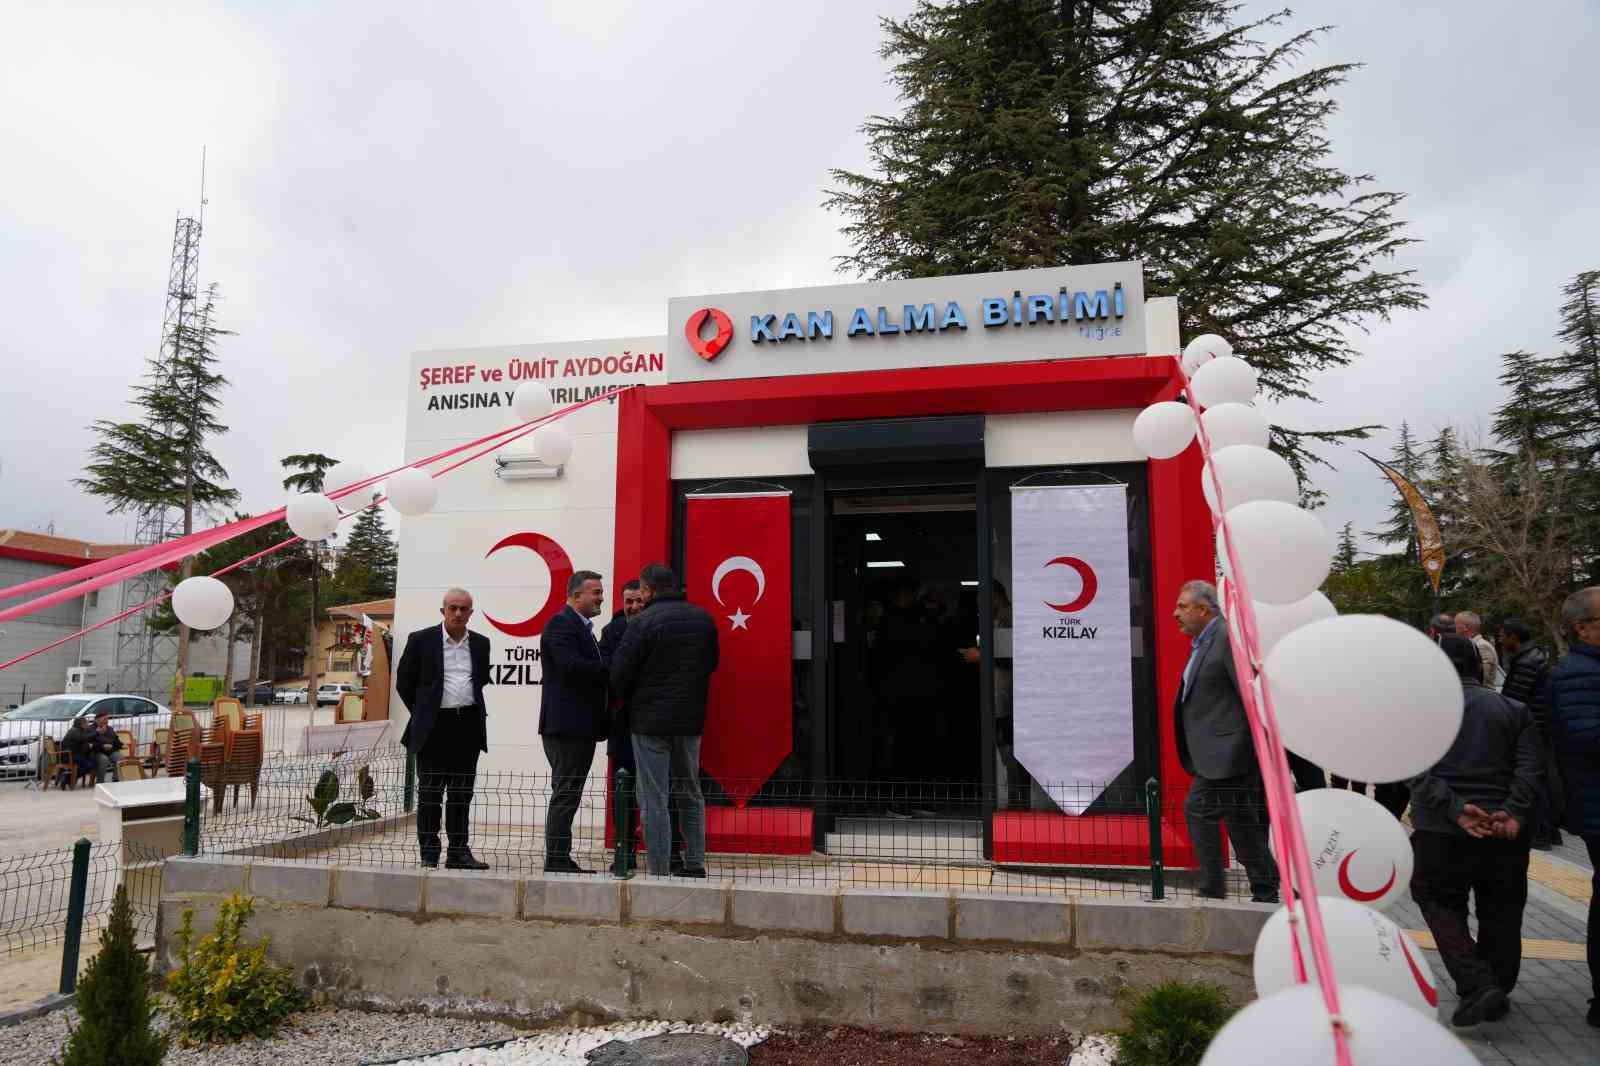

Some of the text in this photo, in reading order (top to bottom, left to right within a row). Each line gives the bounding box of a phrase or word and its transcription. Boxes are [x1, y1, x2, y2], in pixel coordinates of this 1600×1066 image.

[750, 281, 1124, 343] KAN ALMA BİRİMİ
[420, 350, 664, 390] ŞEREF ve ÜMİT AYDOĞAN
[427, 391, 502, 411] ANISINA
[1059, 616, 1081, 626] TÜRK
[1042, 626, 1098, 639] KIZILAY
